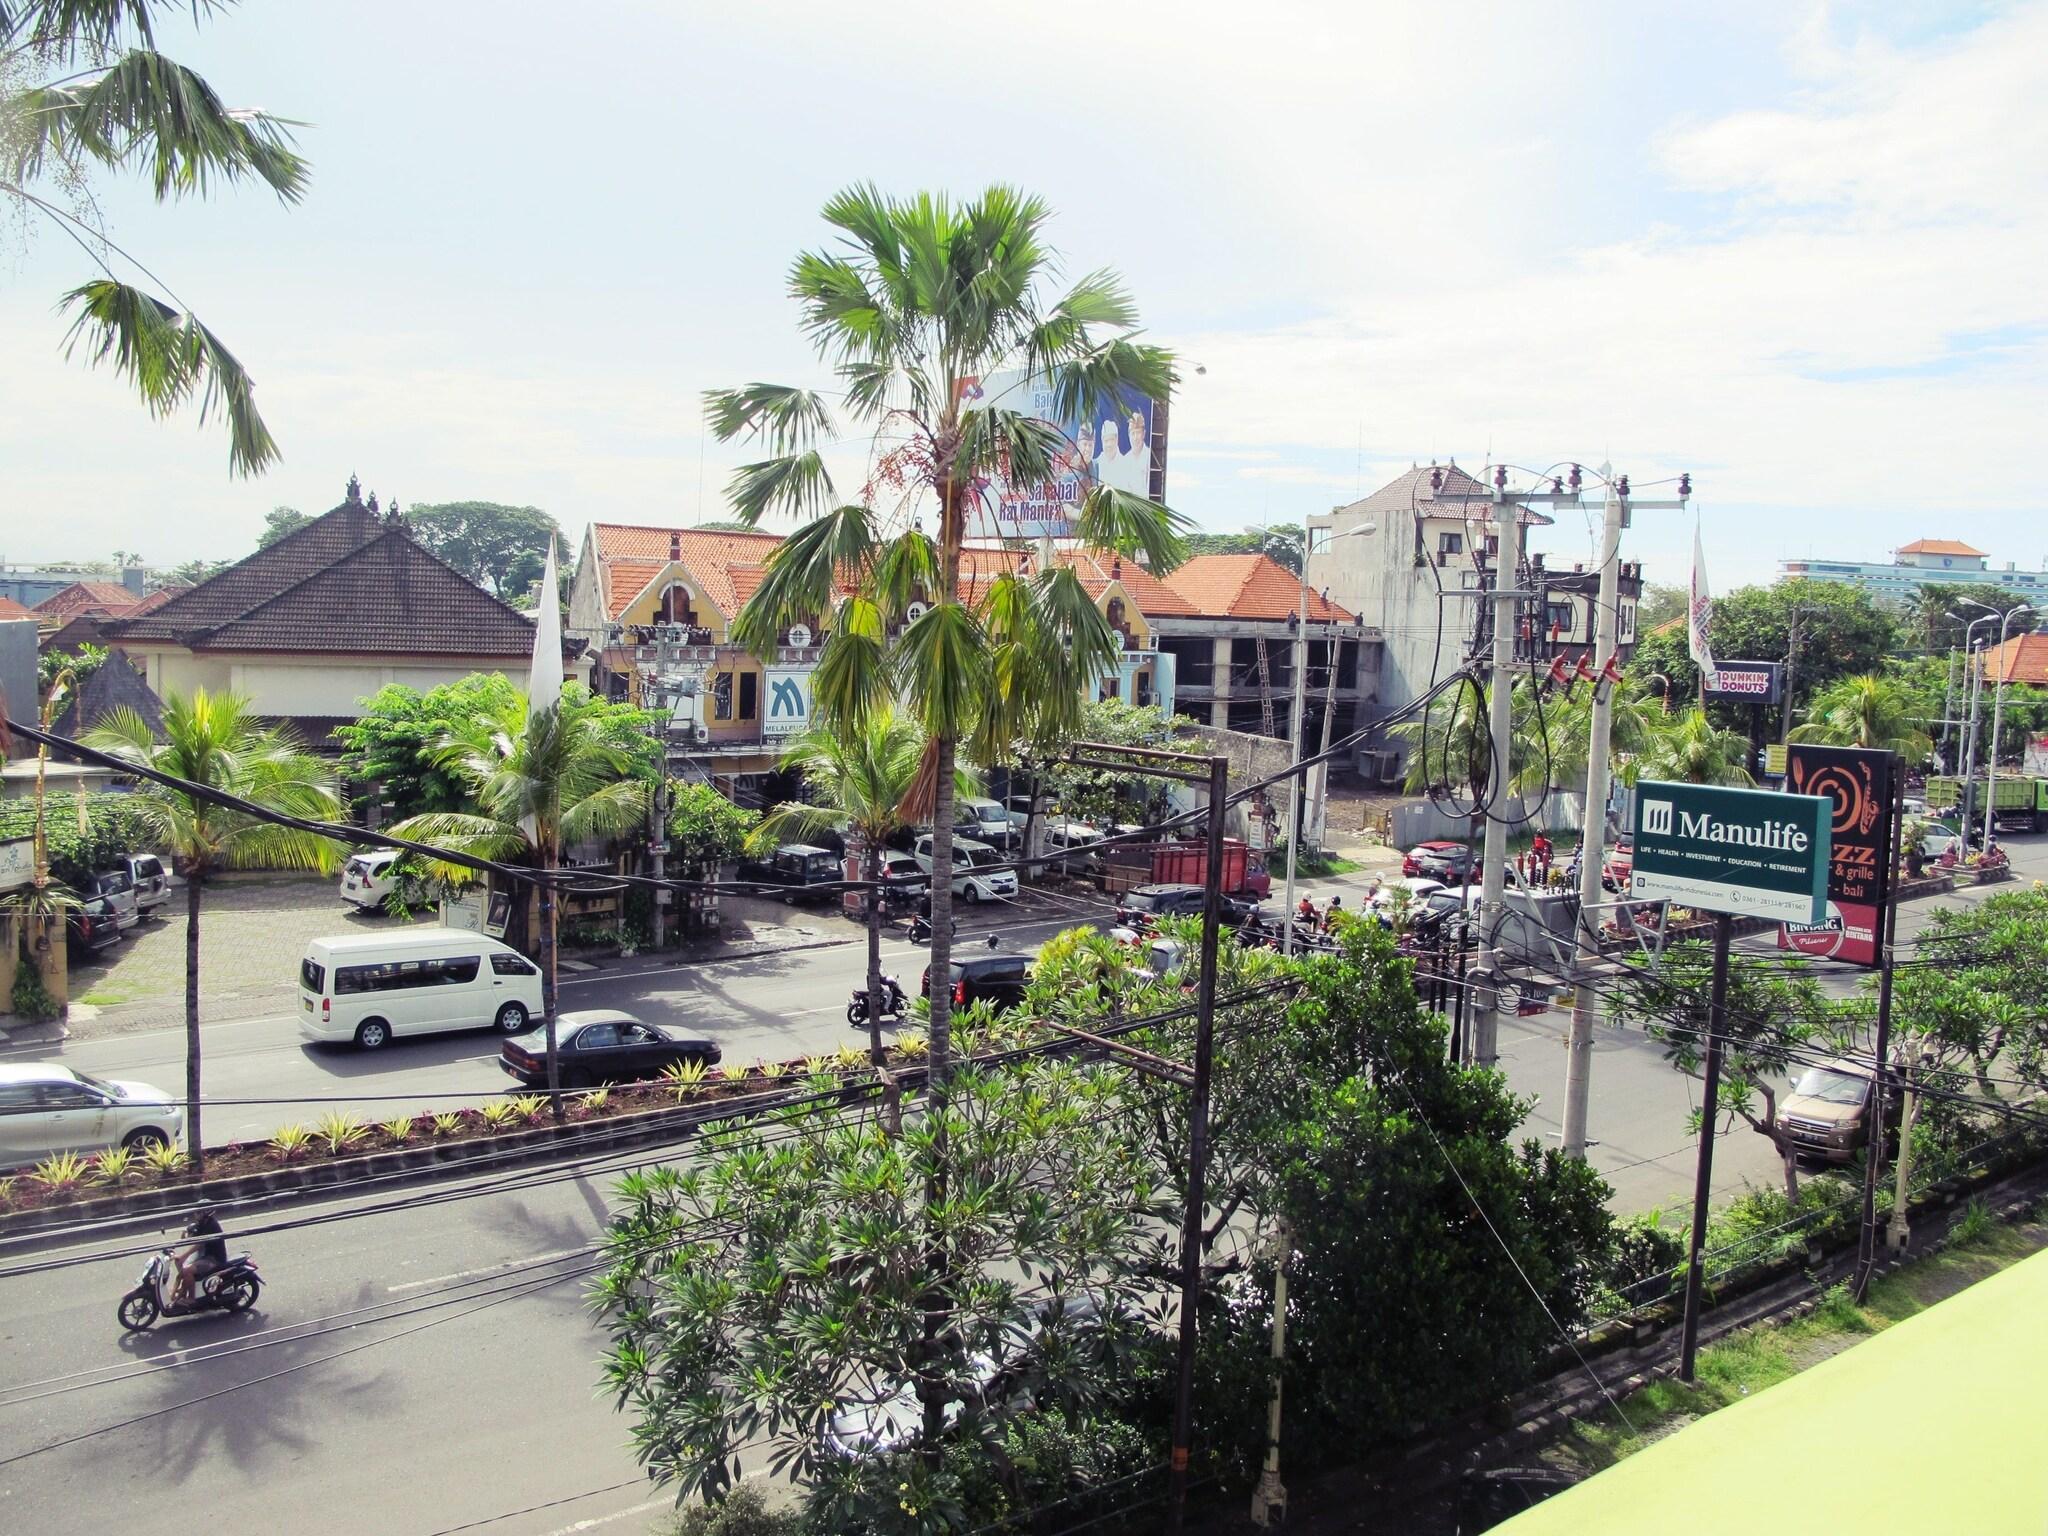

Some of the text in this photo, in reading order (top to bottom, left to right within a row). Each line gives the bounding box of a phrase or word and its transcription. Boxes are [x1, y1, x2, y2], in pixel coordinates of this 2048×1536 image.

[1721, 671, 1768, 683] DUNKIN'
[1677, 810, 1808, 853] Manulife
[1640, 846, 1807, 874] LIFE HEALTH INVESTMENT EDUCATION RETIREMENT
[1834, 863, 1874, 881] & grille
[1843, 882, 1864, 897] bali
